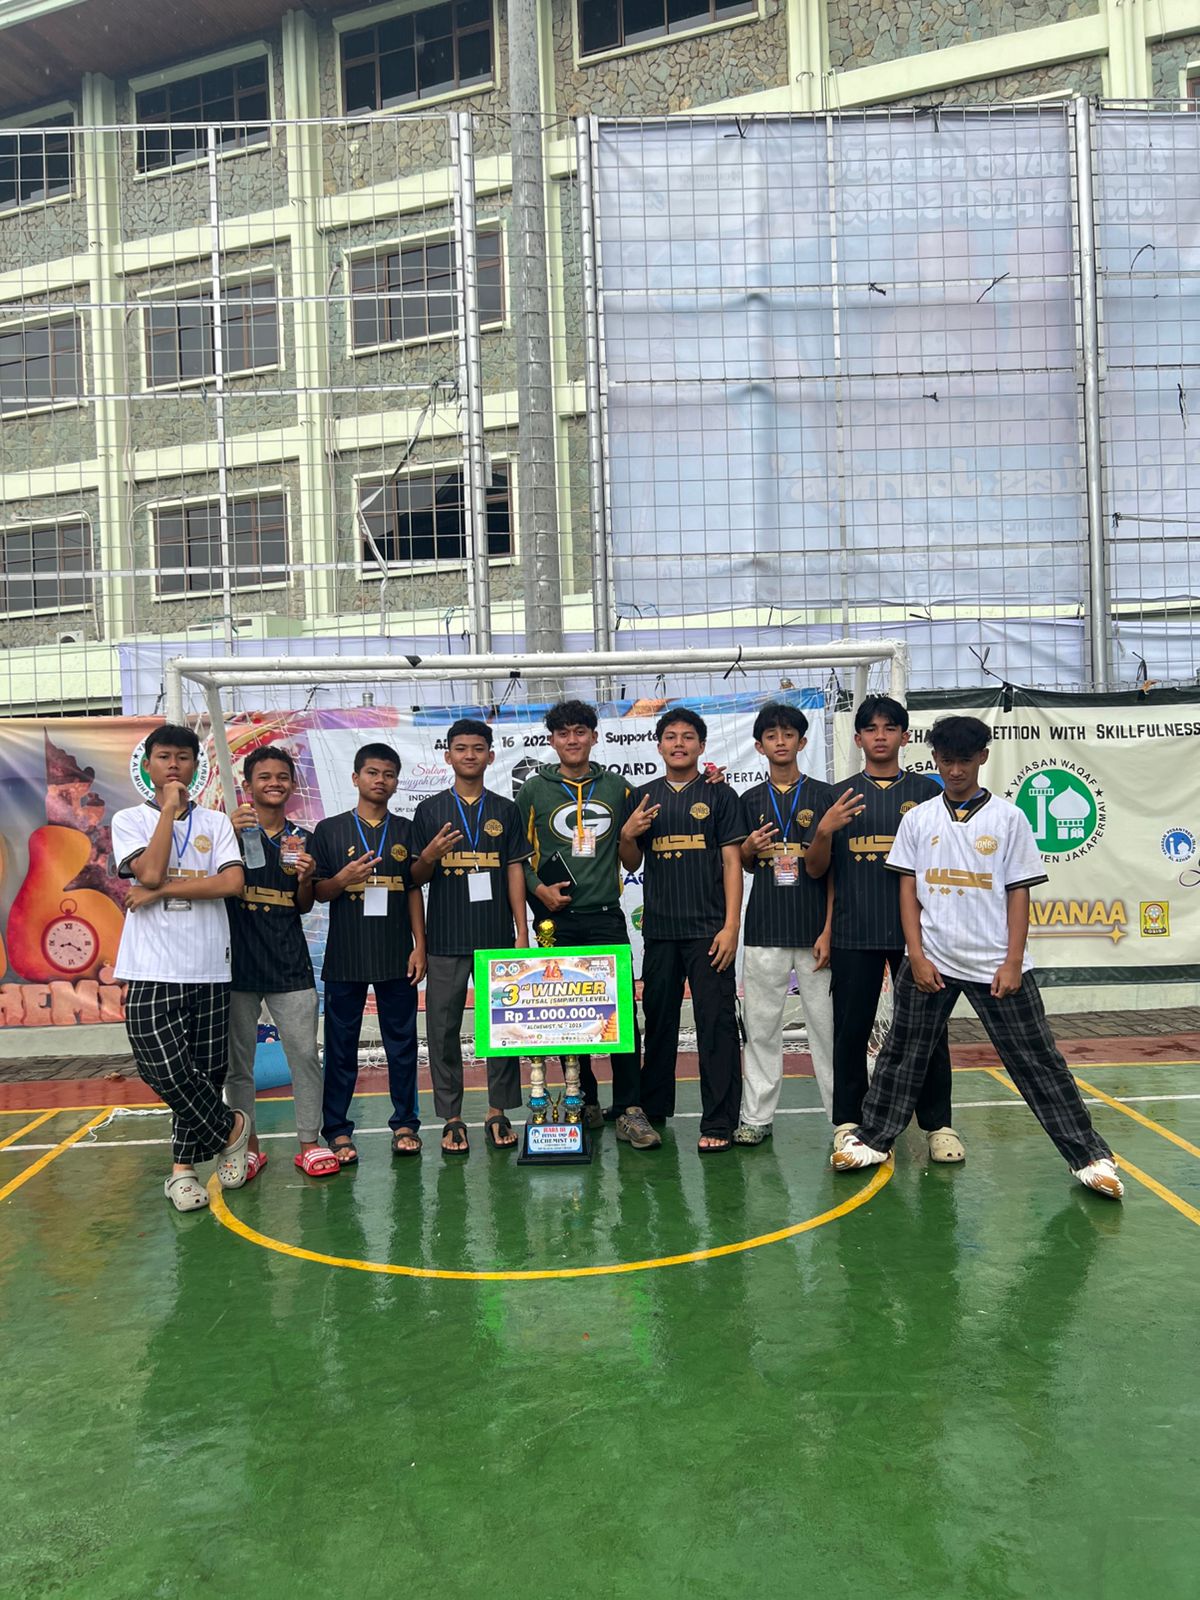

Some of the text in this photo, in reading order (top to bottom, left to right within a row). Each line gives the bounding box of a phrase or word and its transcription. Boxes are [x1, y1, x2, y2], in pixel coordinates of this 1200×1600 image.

[605, 730, 659, 746] Supporte
[992, 722, 1200, 740] ETITION WITH SKILLFULNESS
[501, 736, 515, 748] 16
[1010, 758, 1098, 788] YAYASAN WAQAF
[1064, 801, 1107, 862] JAKAPERMAI
[531, 980, 606, 998] WINNER
[504, 1010, 523, 1023] Rp
